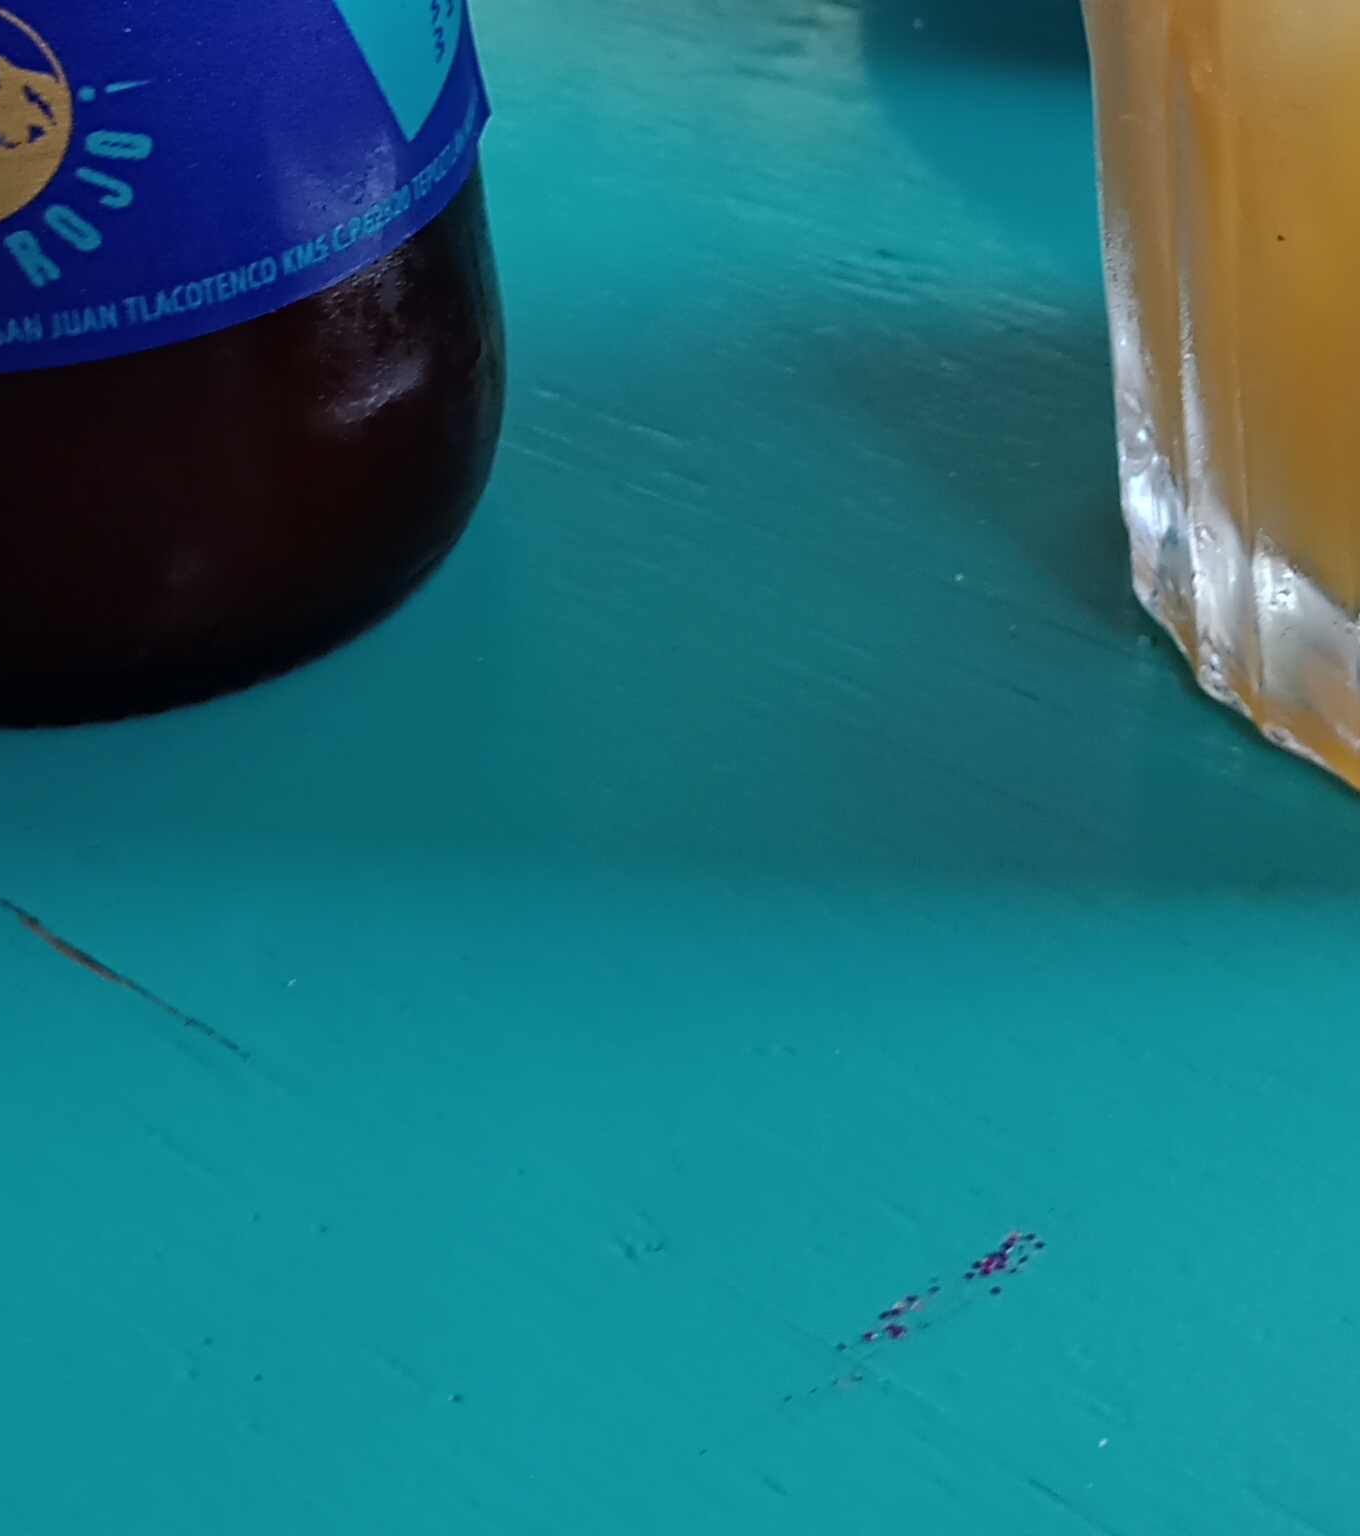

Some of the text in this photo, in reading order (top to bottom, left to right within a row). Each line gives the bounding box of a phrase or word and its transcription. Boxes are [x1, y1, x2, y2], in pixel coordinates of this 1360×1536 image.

[3, 129, 154, 288] ROJO
[50, 302, 119, 340] JUAN
[121, 256, 278, 324] TLACOTENCO
